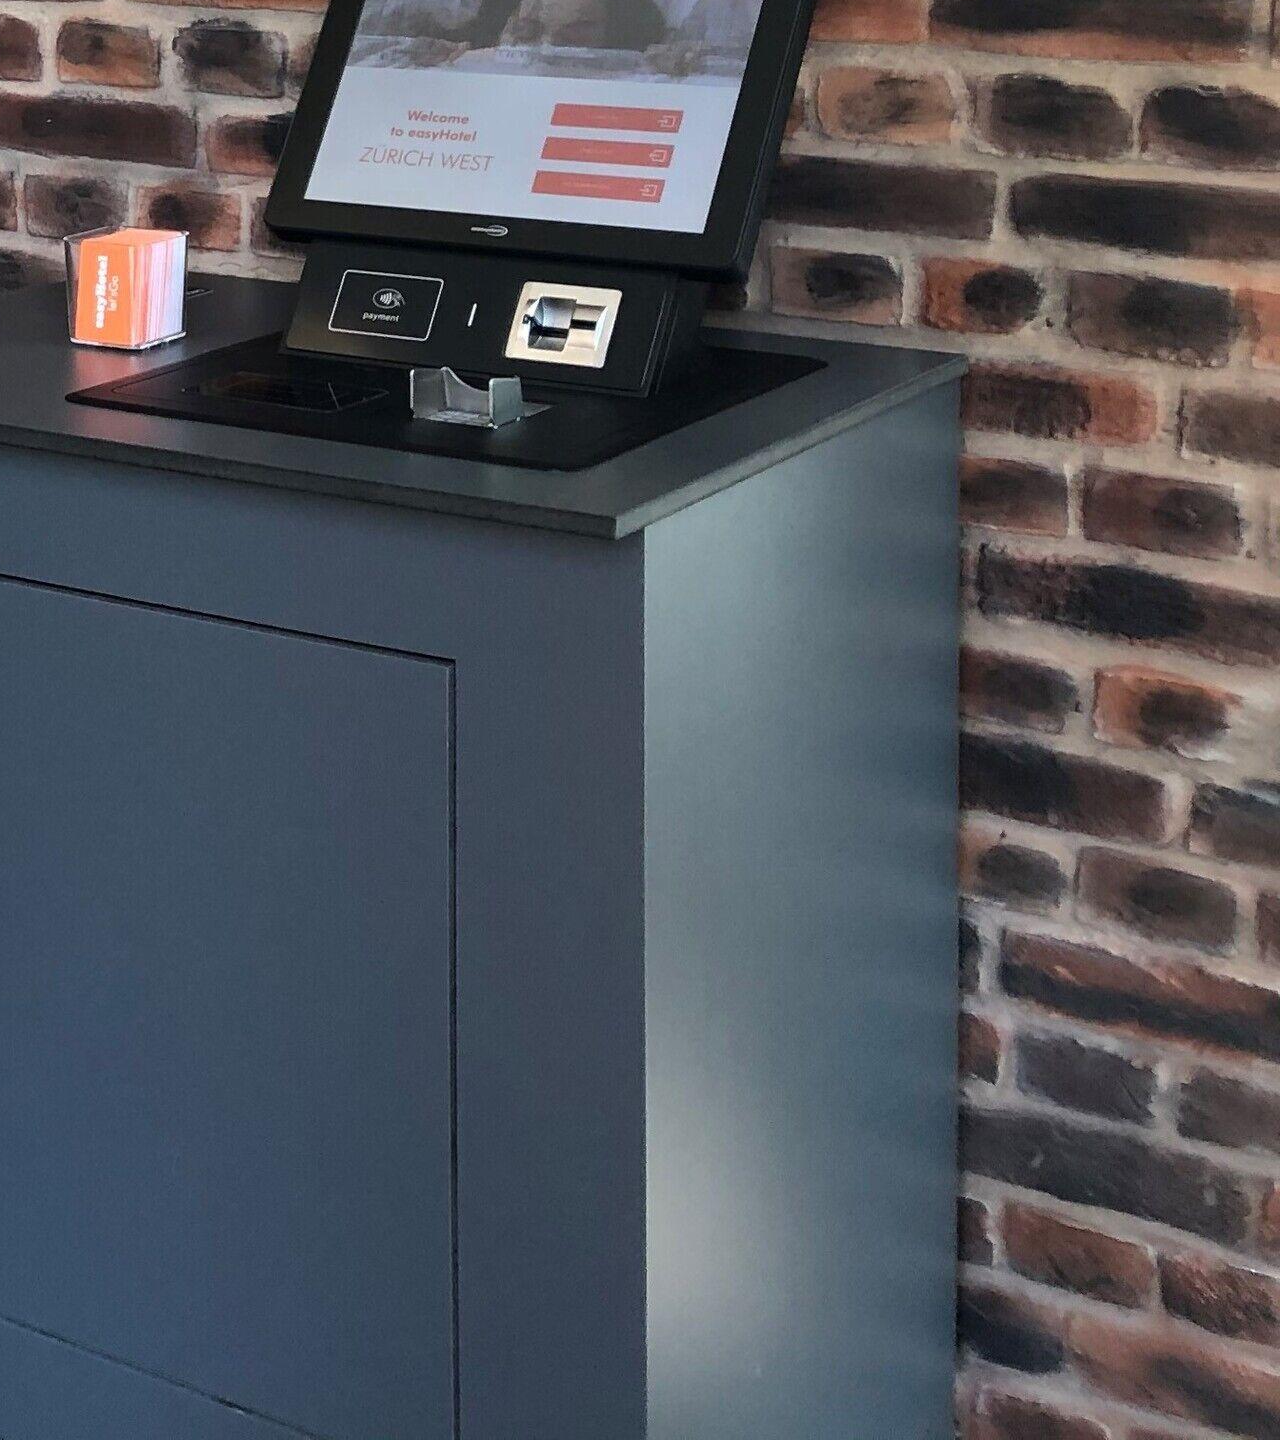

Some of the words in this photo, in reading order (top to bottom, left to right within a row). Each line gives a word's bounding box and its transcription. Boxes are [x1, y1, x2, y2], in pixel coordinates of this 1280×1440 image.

[407, 110, 470, 125] Welcome
[390, 126, 405, 138] to
[408, 129, 478, 142] easyHotel
[359, 144, 435, 168] ZÜRICH
[441, 151, 495, 172] WEST
